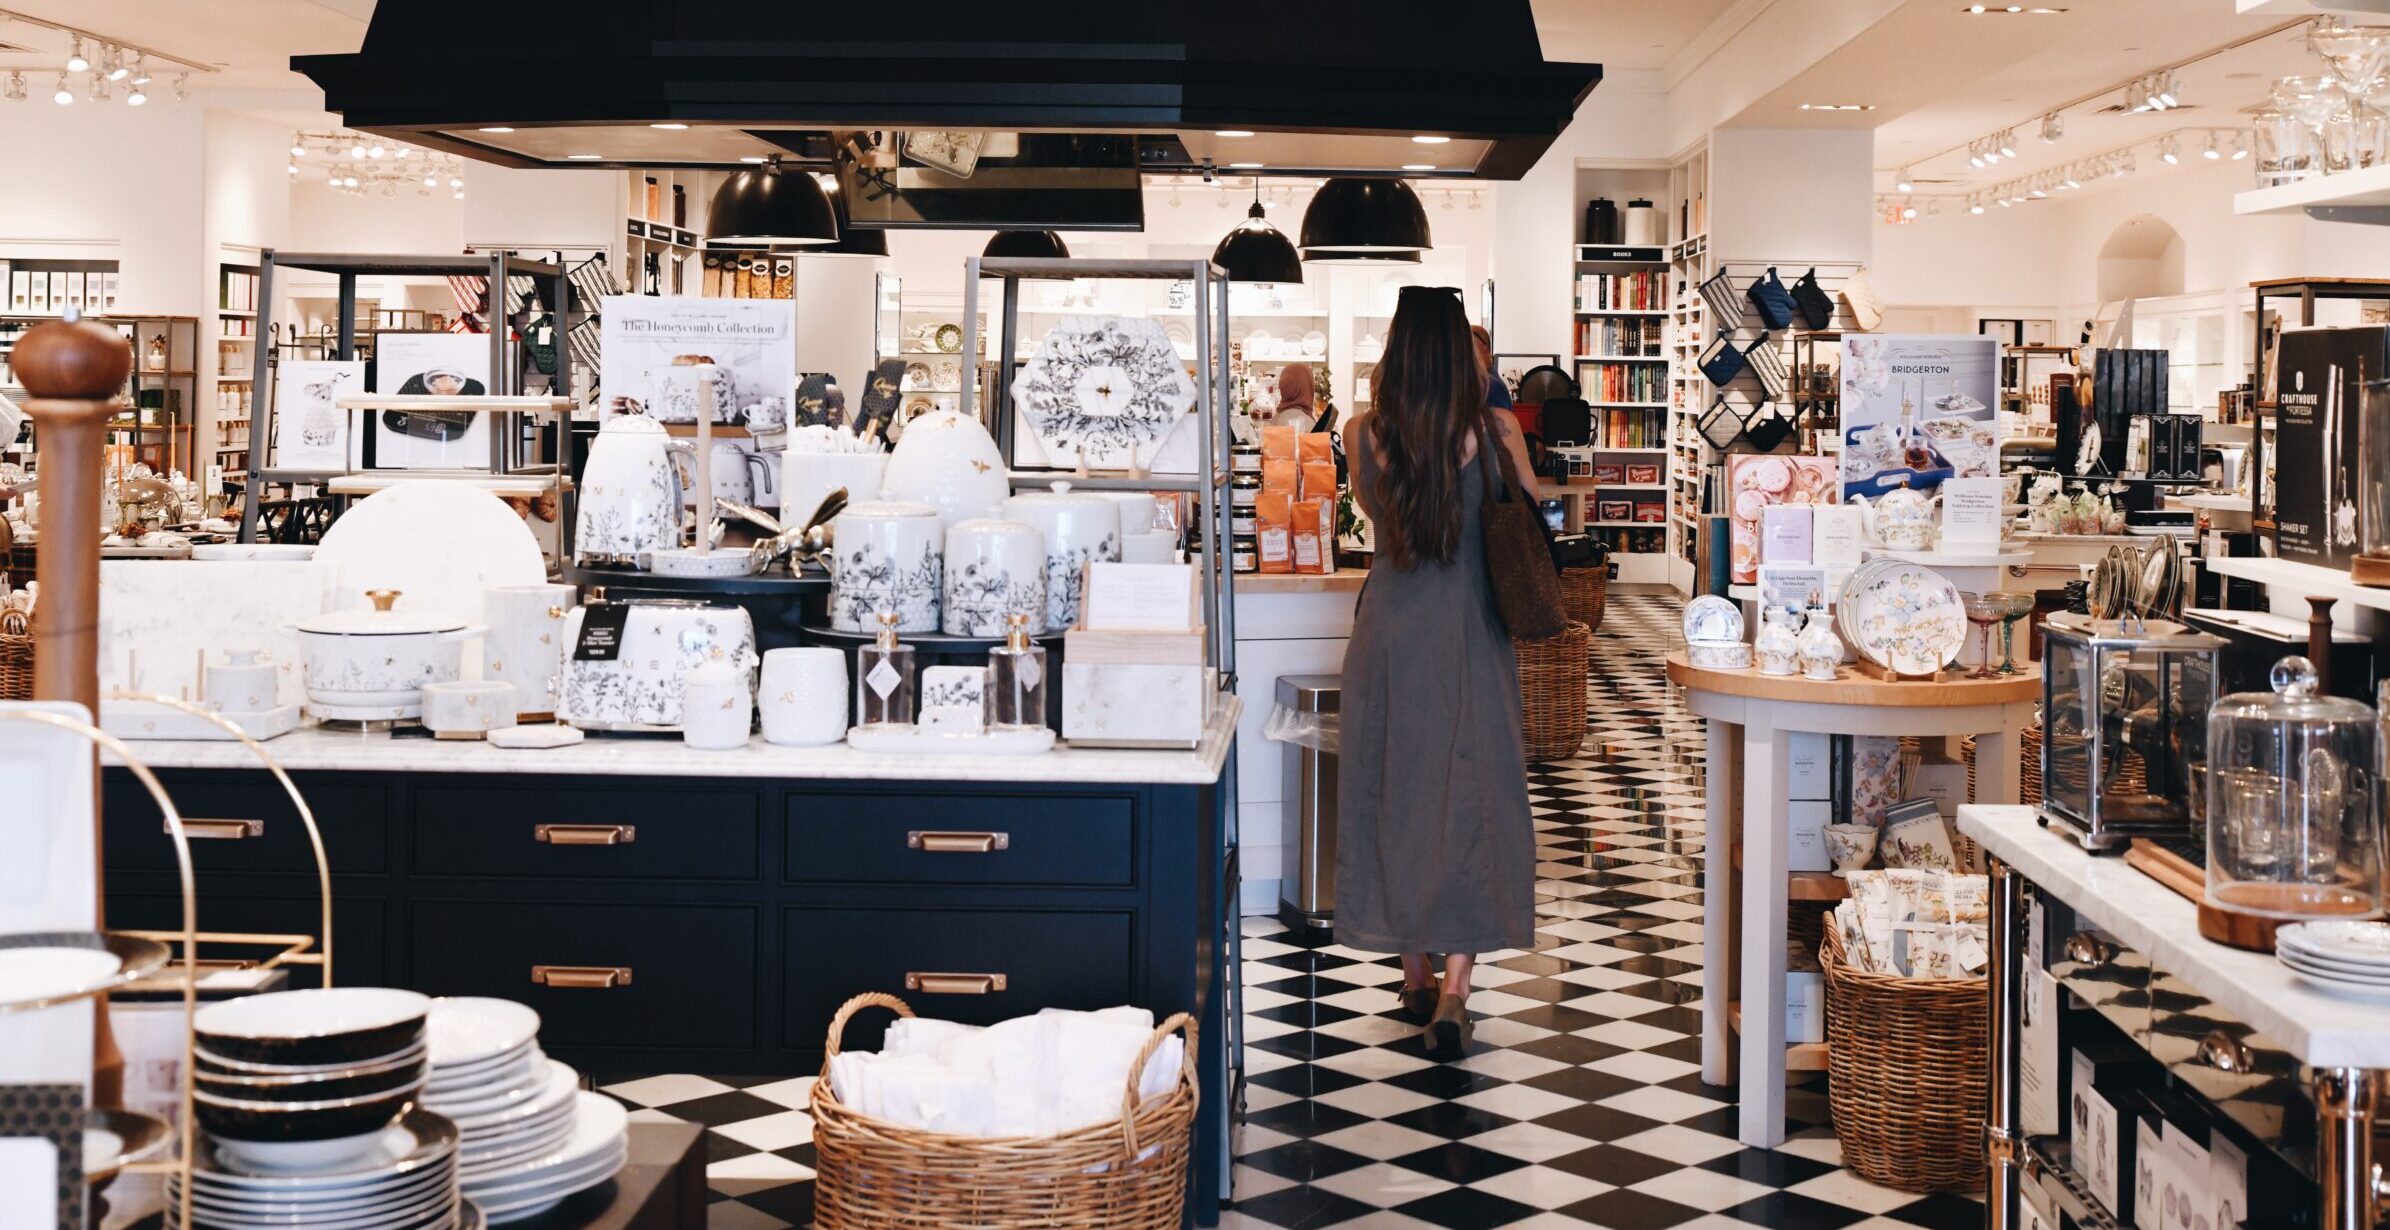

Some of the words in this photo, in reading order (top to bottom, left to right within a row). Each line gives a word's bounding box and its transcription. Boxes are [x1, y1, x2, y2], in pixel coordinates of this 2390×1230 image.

[621, 319, 645, 331] The
[647, 320, 714, 334] Honeycomb
[717, 322, 775, 334] Collection
[1891, 365, 1950, 374] BRIDGERTON
[2281, 394, 2318, 405] CRAFTHOUSE
[2281, 521, 2298, 533] SHAKER
[2300, 524, 2309, 535] SET
